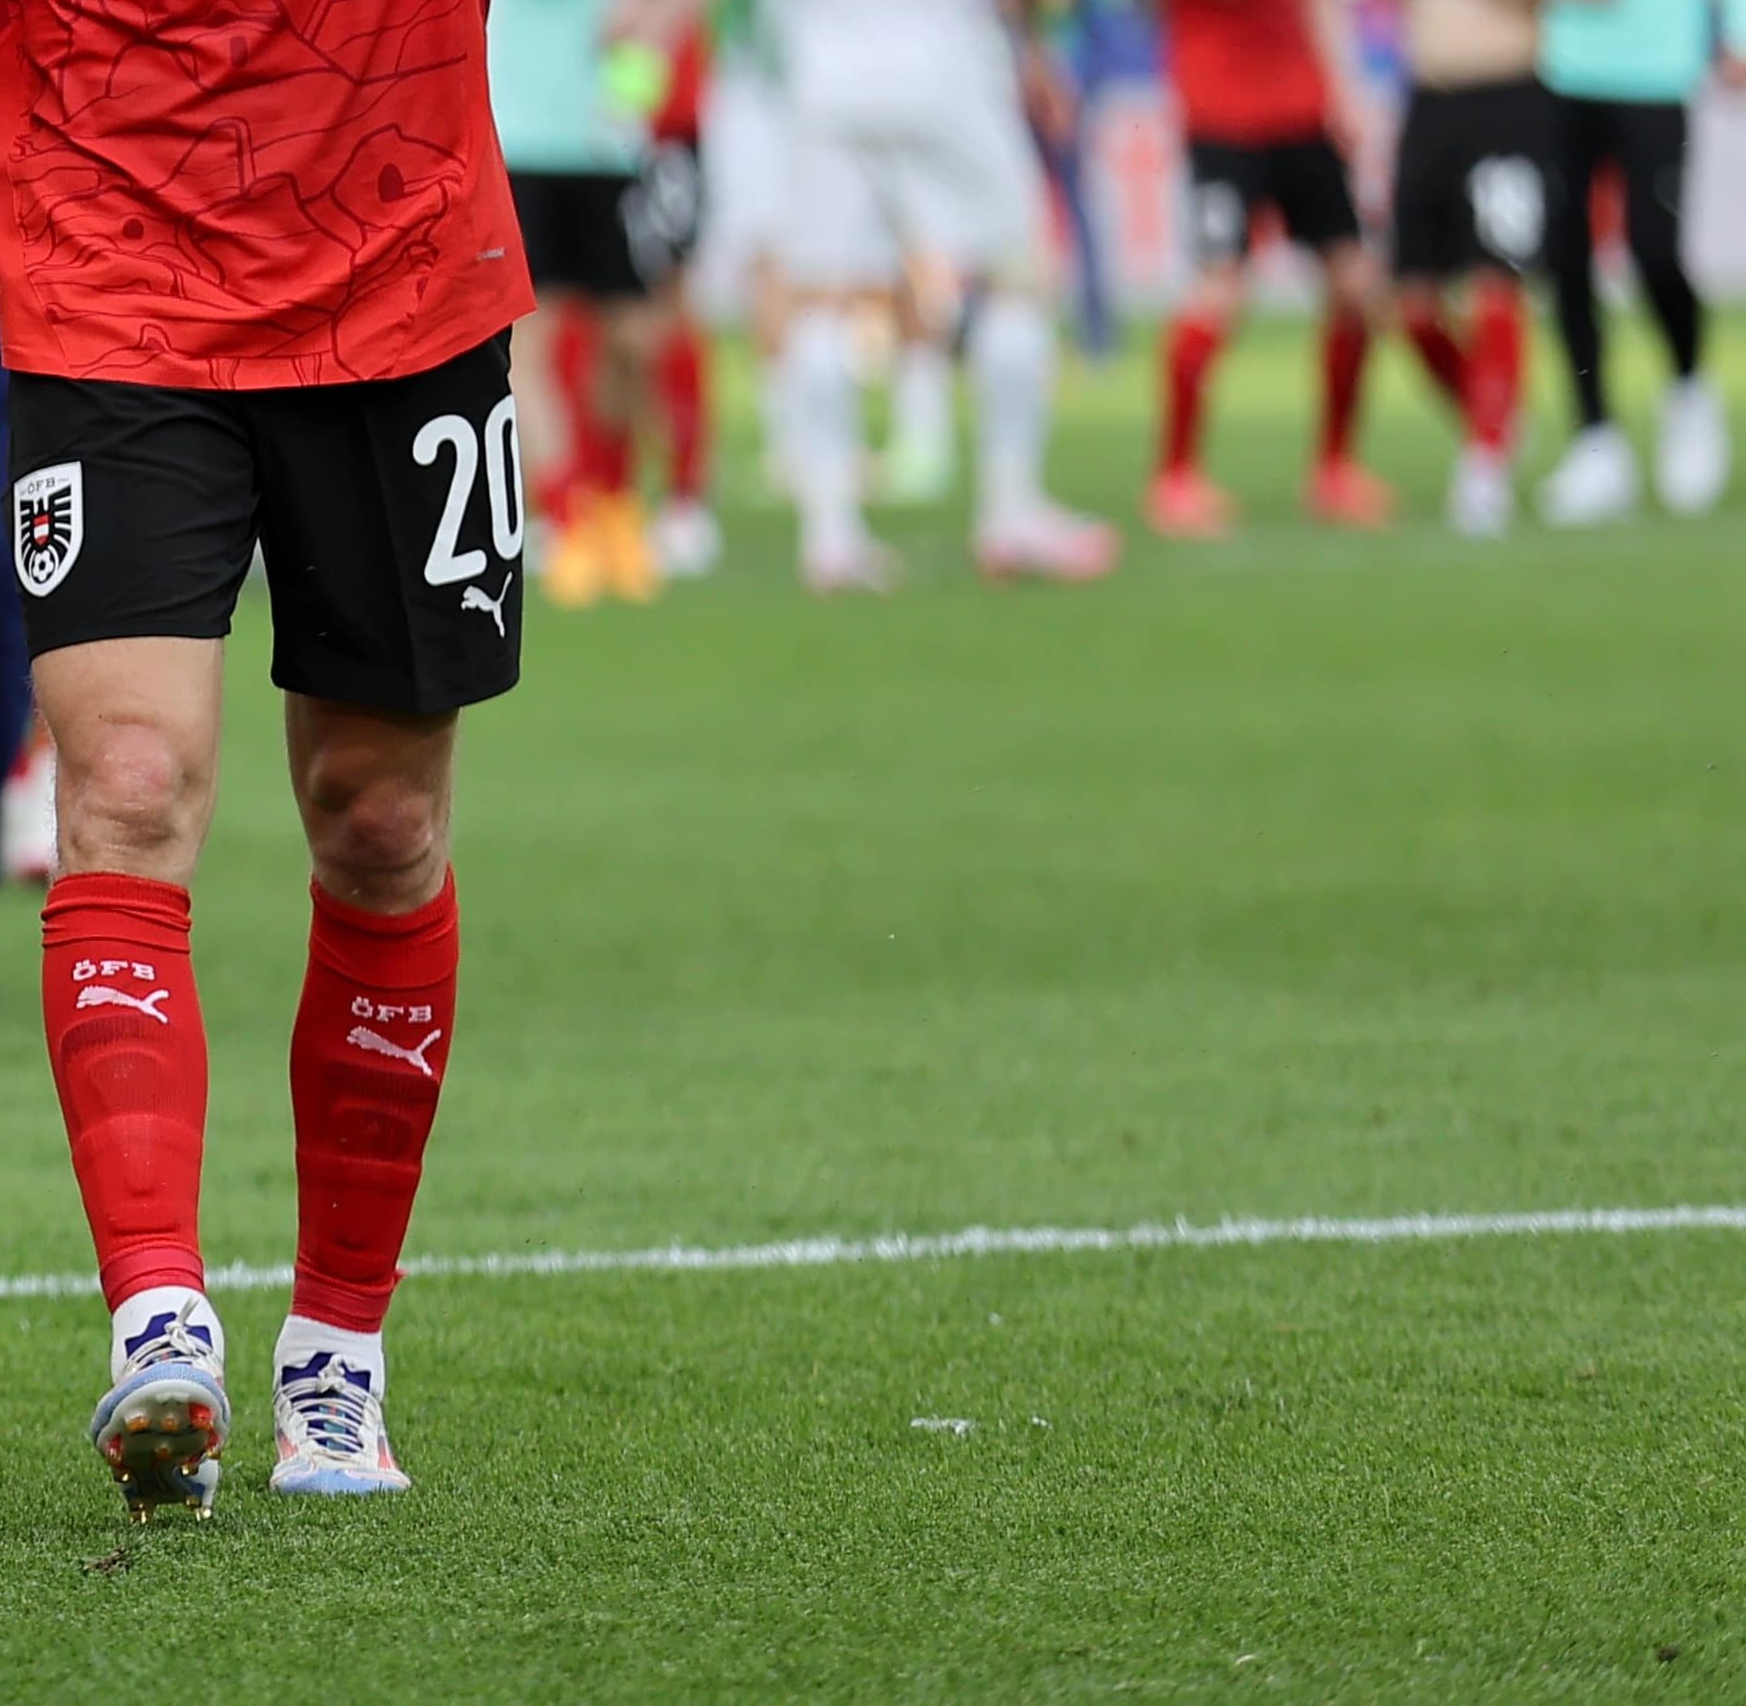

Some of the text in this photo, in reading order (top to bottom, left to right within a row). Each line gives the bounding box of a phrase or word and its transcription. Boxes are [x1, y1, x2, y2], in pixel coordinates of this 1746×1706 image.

[412, 393, 525, 586] 20
[72, 959, 156, 981] ÖFB
[351, 995, 432, 1023] ÖFB
